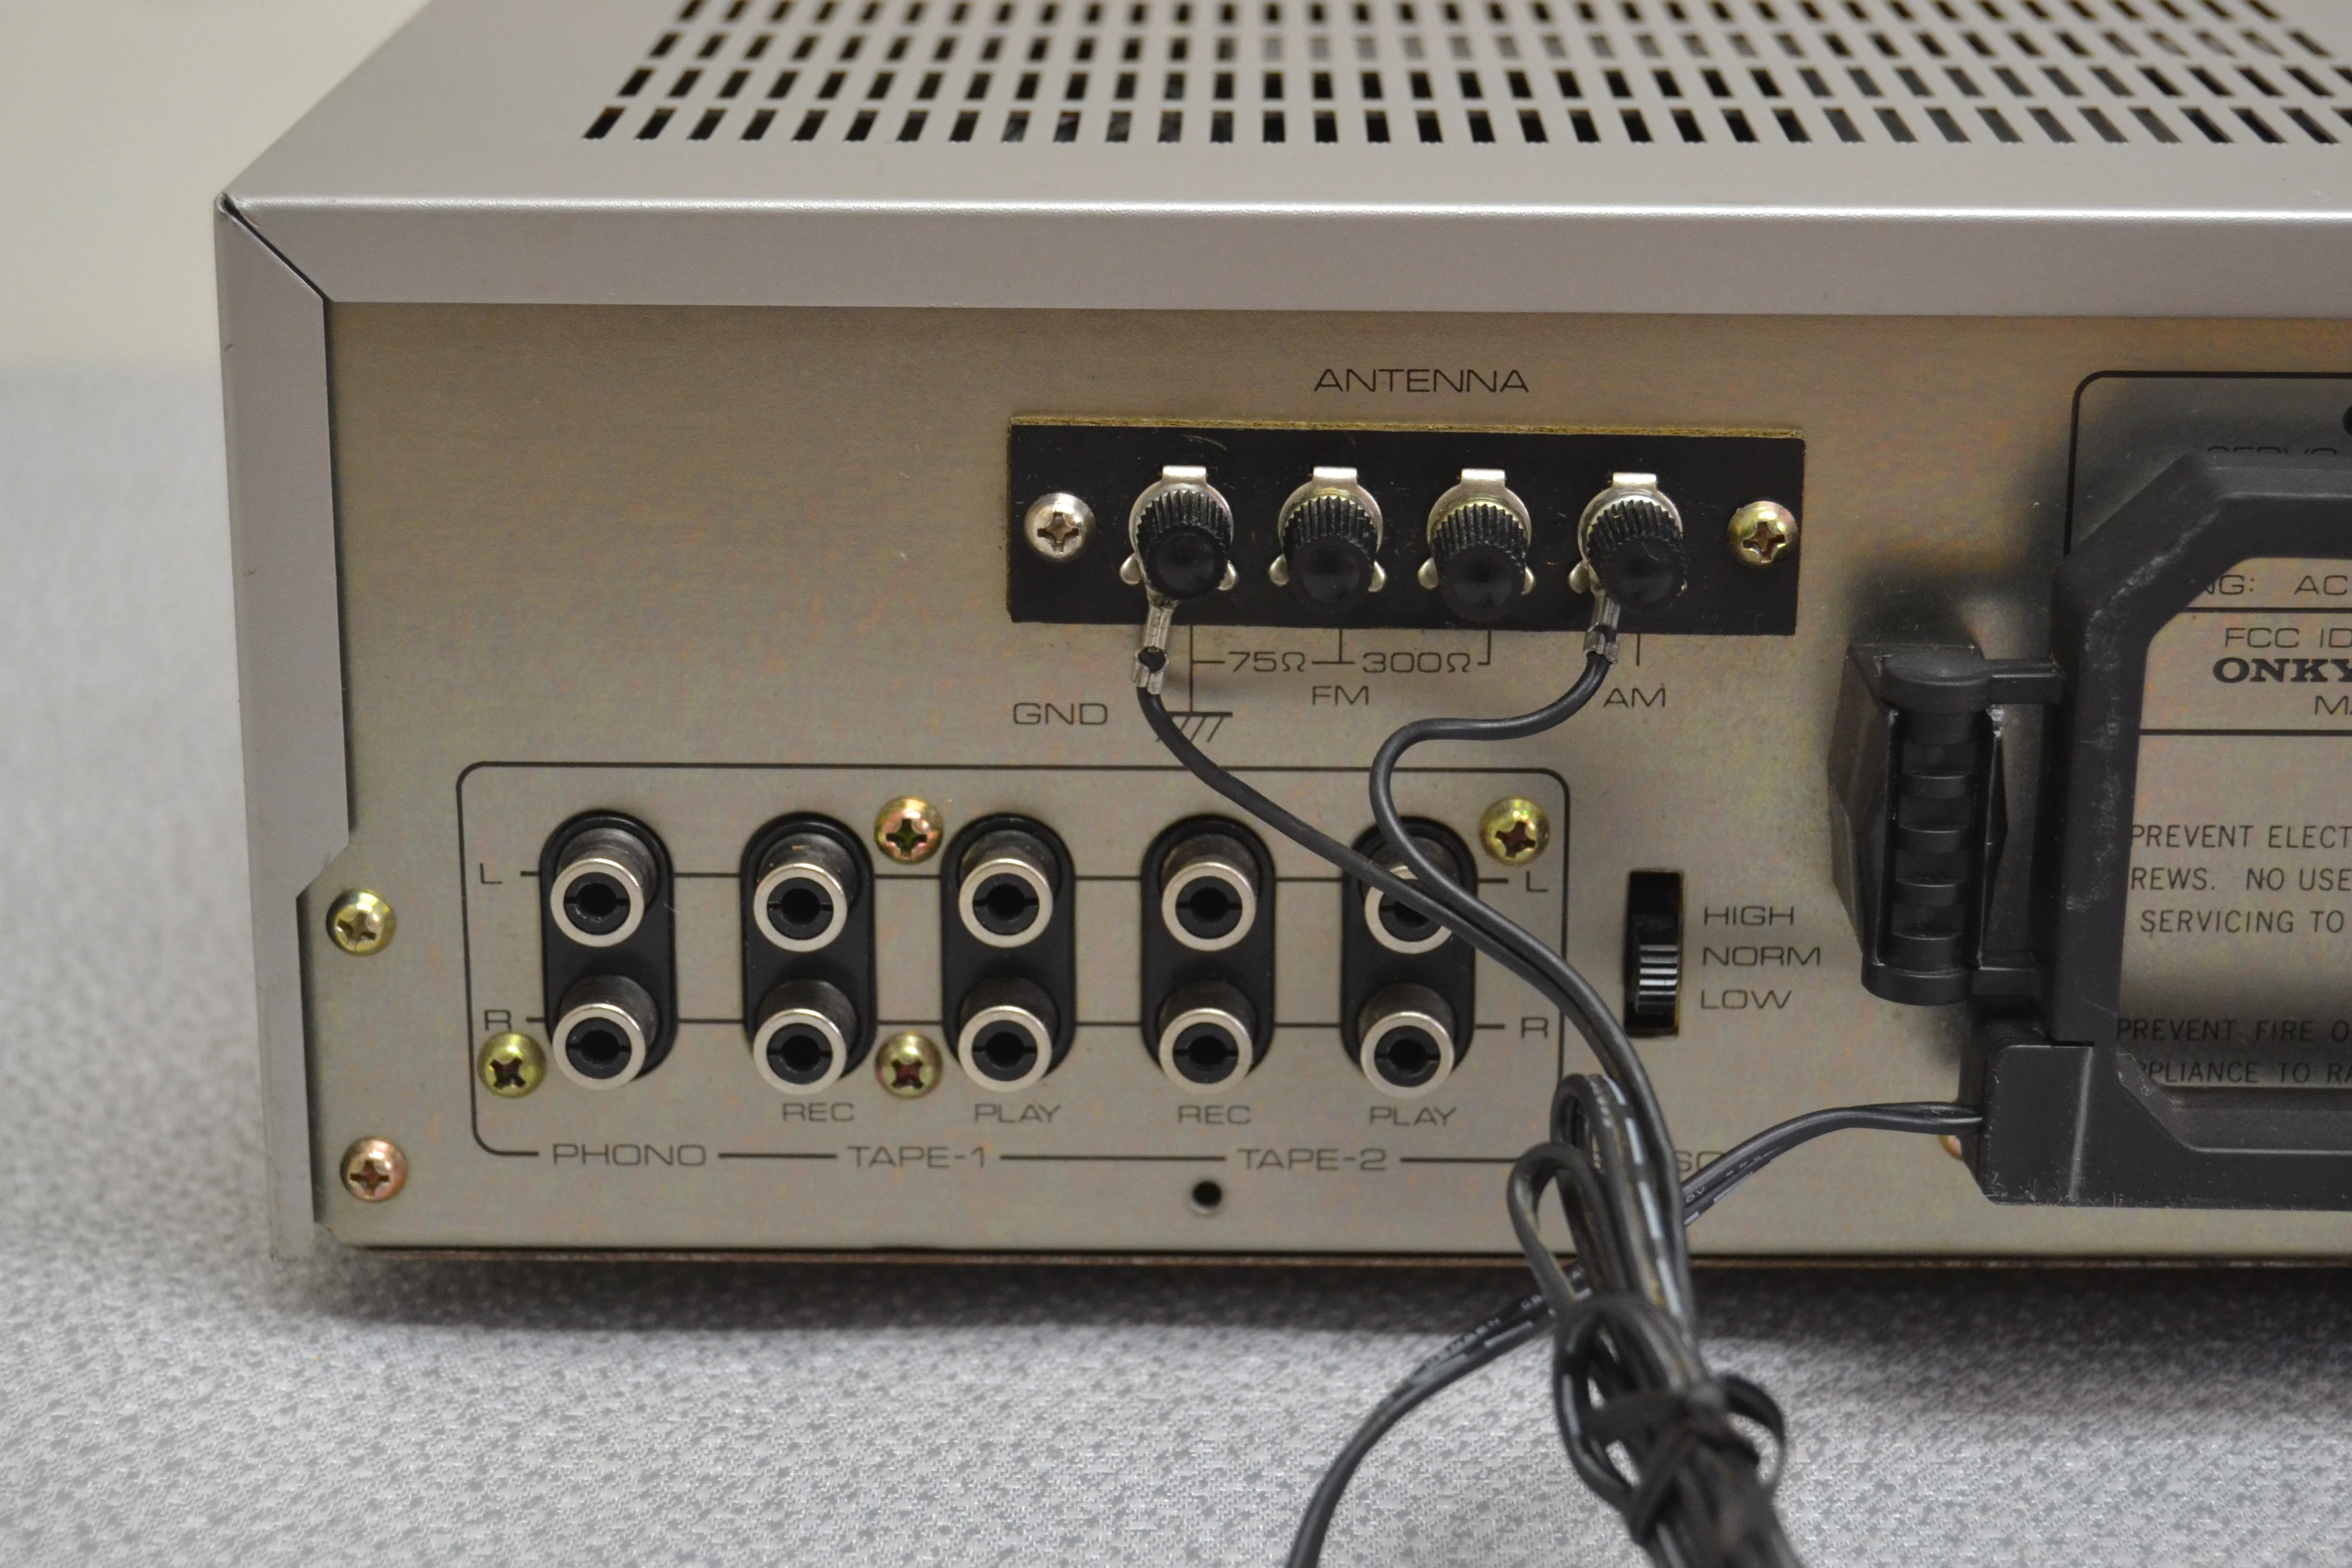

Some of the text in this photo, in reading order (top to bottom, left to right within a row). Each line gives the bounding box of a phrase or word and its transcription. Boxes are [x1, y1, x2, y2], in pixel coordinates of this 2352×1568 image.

[1314, 369, 1529, 393] ANTENNA
[2294, 575, 2348, 596] AC
[2225, 627, 2299, 648] FCC
[1312, 685, 1369, 705] FM
[1603, 684, 1665, 708] AM
[1013, 702, 1108, 725] GND
[2268, 825, 2352, 848] ELECT
[479, 863, 503, 885] L
[1526, 871, 1548, 893] L
[2246, 868, 2285, 891] NO
[1704, 906, 1794, 926] HIGH
[2141, 910, 2344, 933] SERVICING TO
[1703, 946, 1821, 966] NORM
[1701, 990, 1792, 1009] LOW
[484, 1010, 511, 1031] R
[1521, 1017, 1549, 1038] R
[2117, 1018, 2238, 1042] PREVENT
[2256, 1018, 2316, 1043] FIRE
[2276, 1062, 2310, 1084] TO
[782, 1102, 853, 1122] REC
[974, 1104, 1060, 1123] PLAY
[1178, 1105, 1250, 1124] REC
[1369, 1107, 1456, 1126] PLAY
[553, 1143, 706, 1166] PHONO
[847, 1146, 984, 1168] TAPE-1
[1238, 1147, 1387, 1171] TAPE-2
